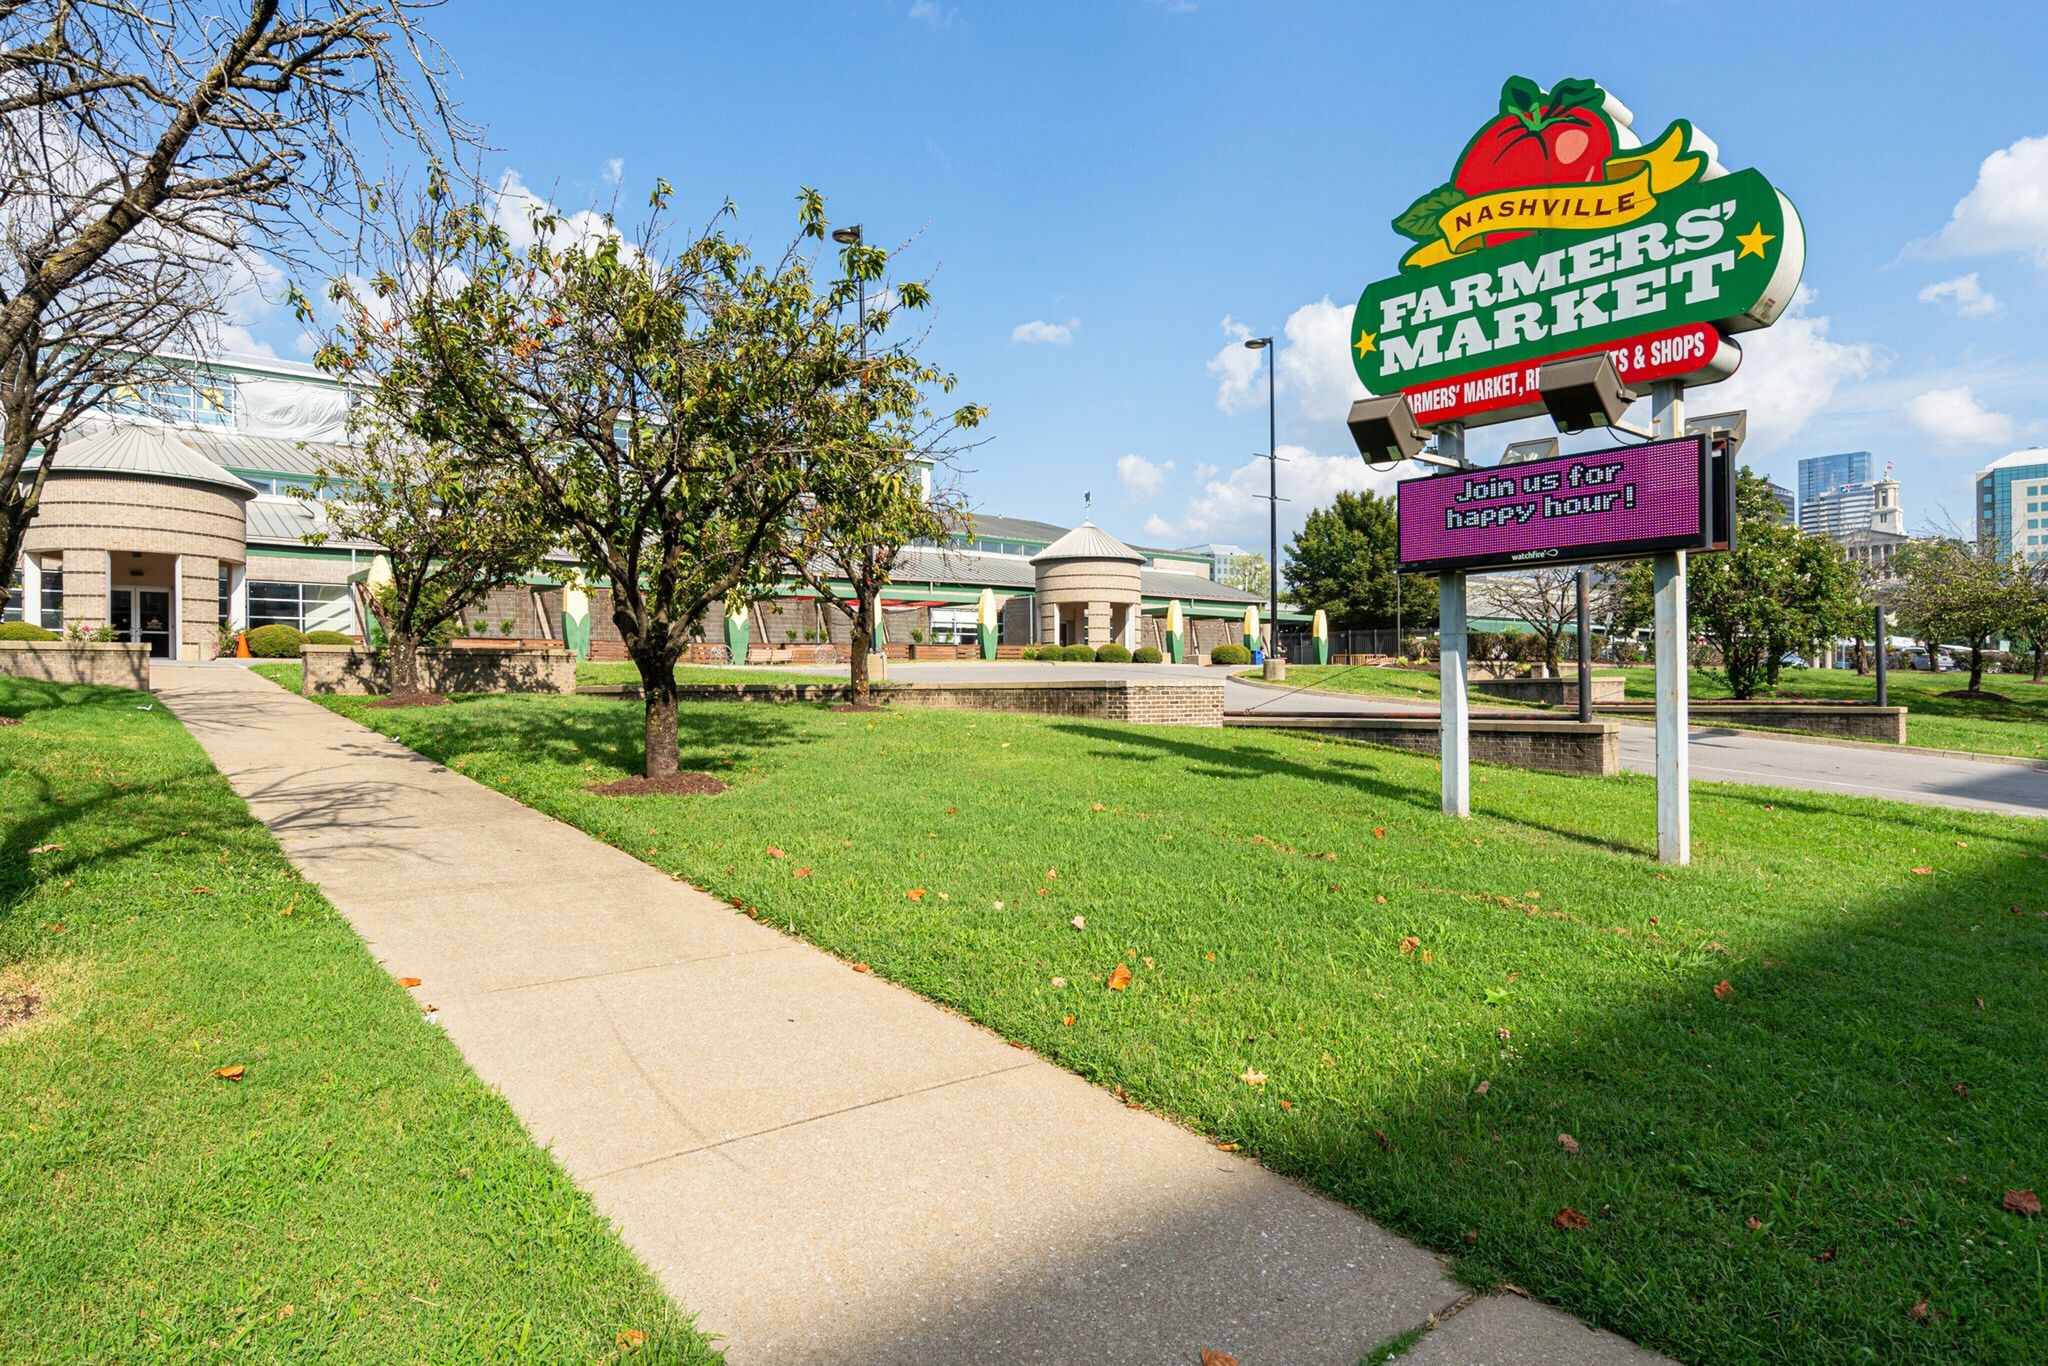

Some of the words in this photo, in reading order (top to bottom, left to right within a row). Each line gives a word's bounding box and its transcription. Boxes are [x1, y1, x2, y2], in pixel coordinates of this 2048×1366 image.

[1455, 191, 1635, 232] NASHVILLE
[1379, 249, 1735, 377] MARKET
[1464, 372, 1524, 404] MARKET,
[1633, 344, 1647, 370] &
[1650, 331, 1705, 366] SHOPS
[1456, 478, 1514, 502] Join
[1522, 472, 1559, 493] us
[1568, 463, 1624, 488] for
[1446, 502, 1536, 528] happy
[1511, 550, 1545, 561] watchfire
